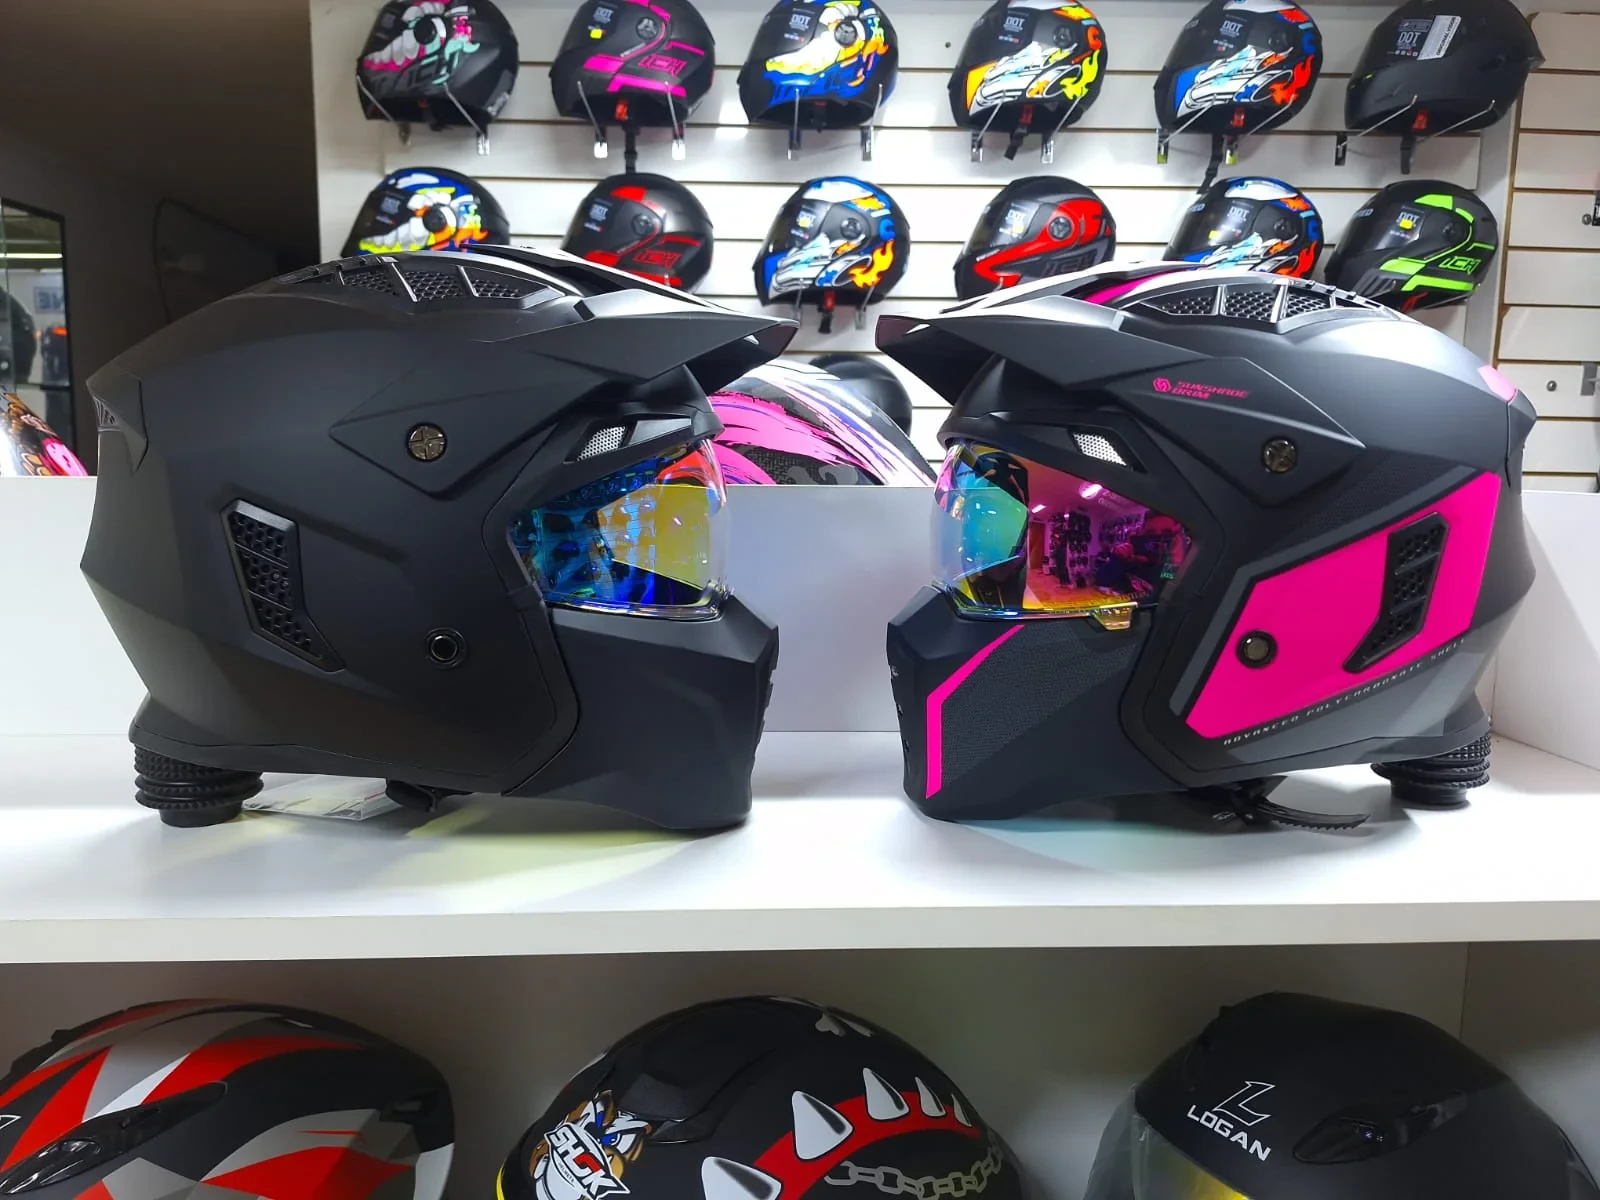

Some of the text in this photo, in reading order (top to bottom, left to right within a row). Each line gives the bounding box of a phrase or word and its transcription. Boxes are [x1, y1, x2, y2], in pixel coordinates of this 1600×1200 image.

[791, 14, 811, 25] DOT
[1005, 16, 1025, 27] DOT
[1222, 20, 1243, 32] DOT
[1398, 31, 1422, 44] DOT
[1229, 206, 1249, 219] DOT
[1223, 637, 1465, 745] ADVANCED POLYCARBONATE SHELL
[1186, 1104, 1272, 1162] LOGAN
